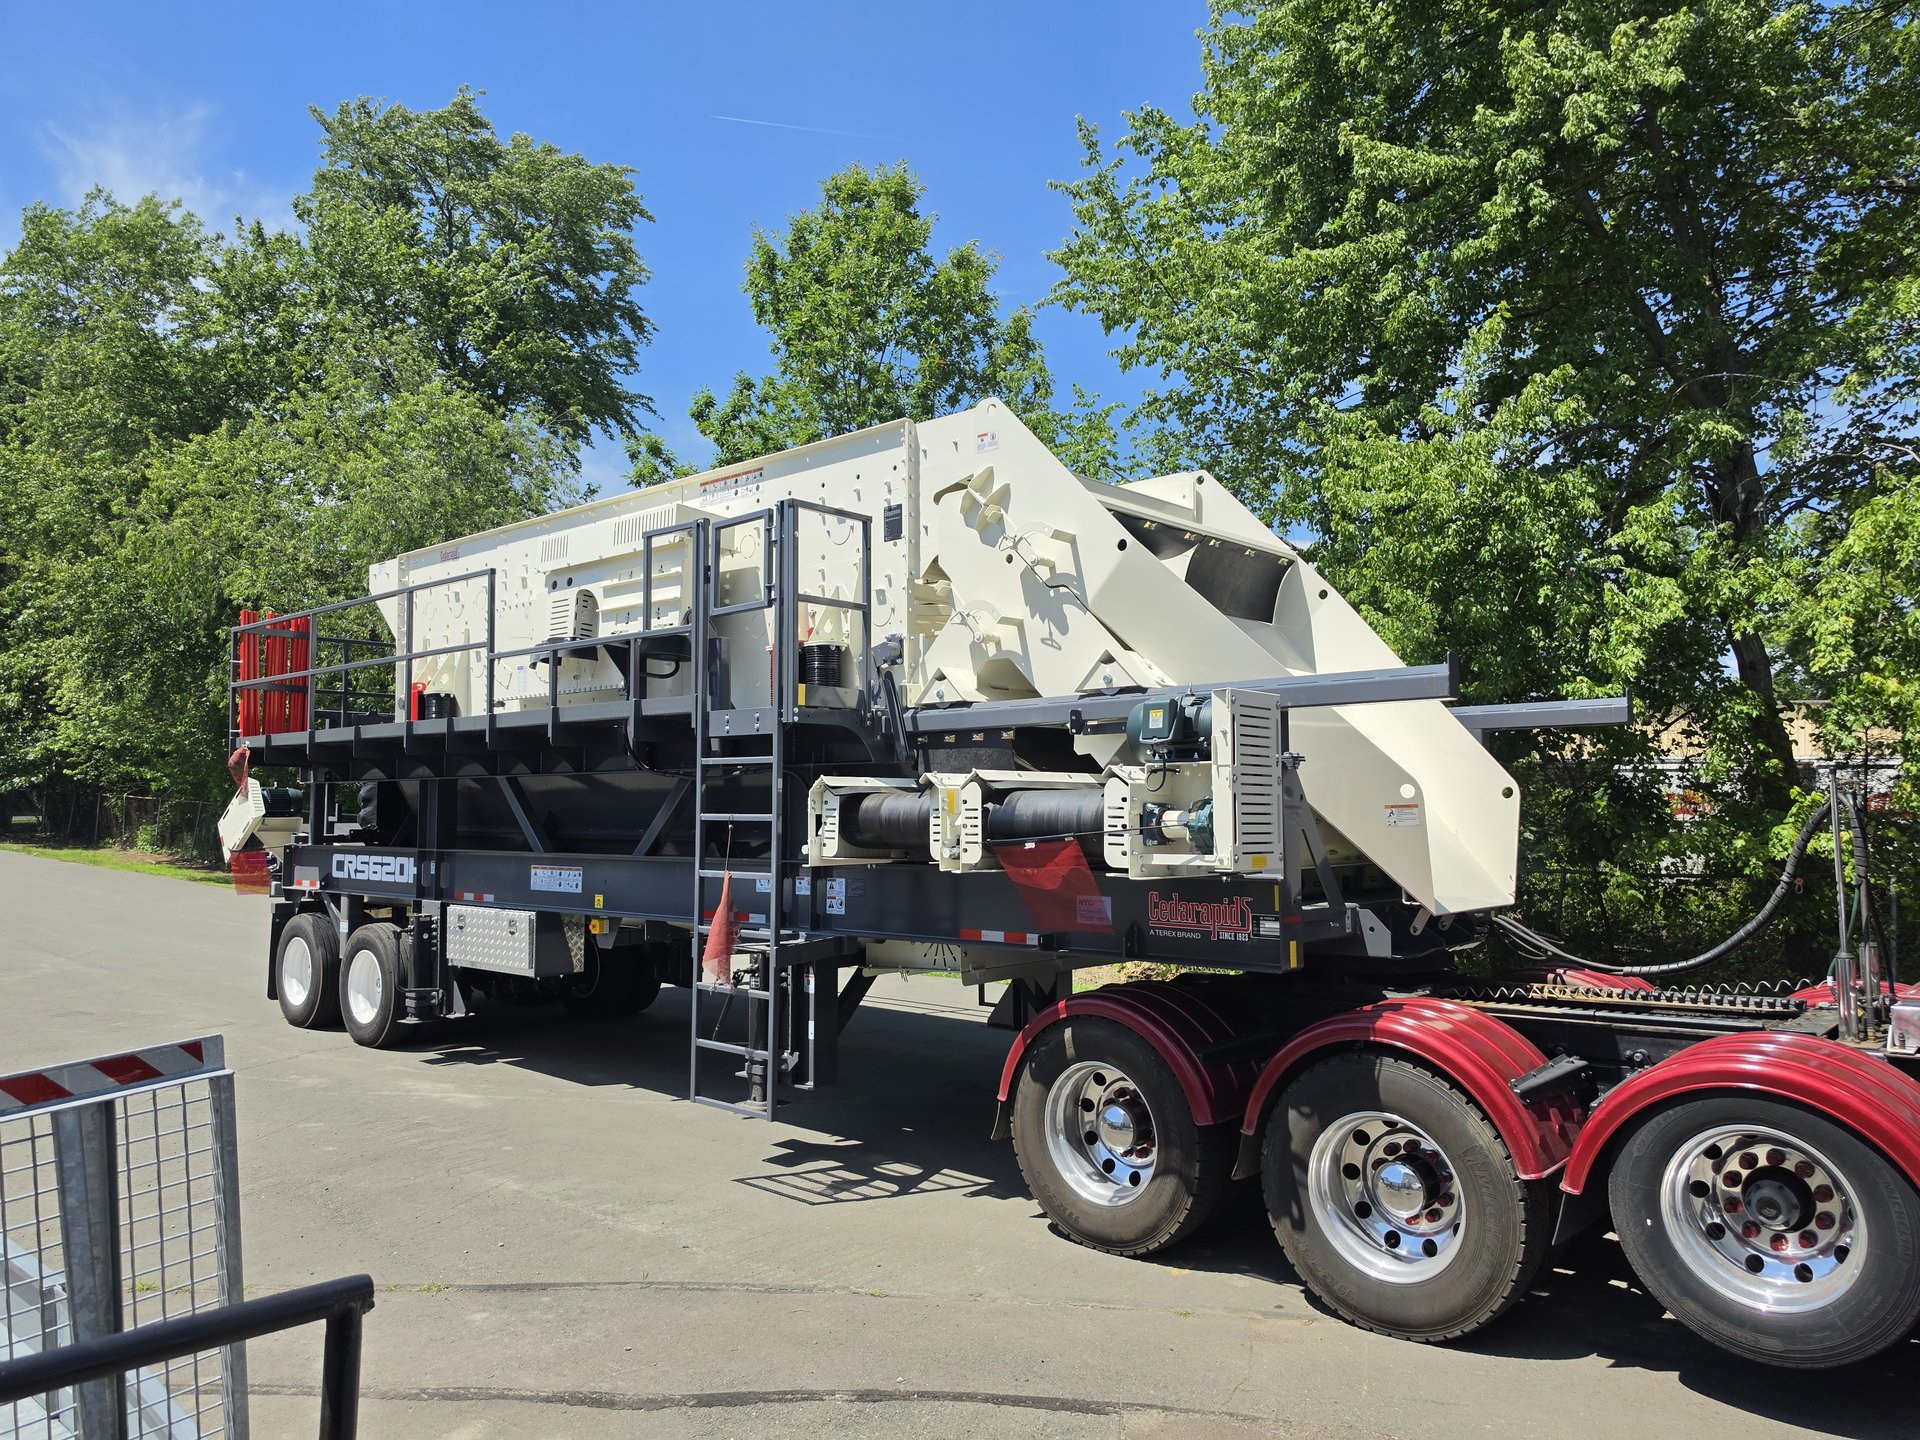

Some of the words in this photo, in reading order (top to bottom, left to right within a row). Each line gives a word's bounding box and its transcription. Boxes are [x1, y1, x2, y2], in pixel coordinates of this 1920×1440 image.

[1155, 929, 1177, 938] TEREX
[1177, 930, 1201, 939] BRAND
[1219, 931, 1235, 941] SINCE
[1236, 932, 1249, 942] 1923
